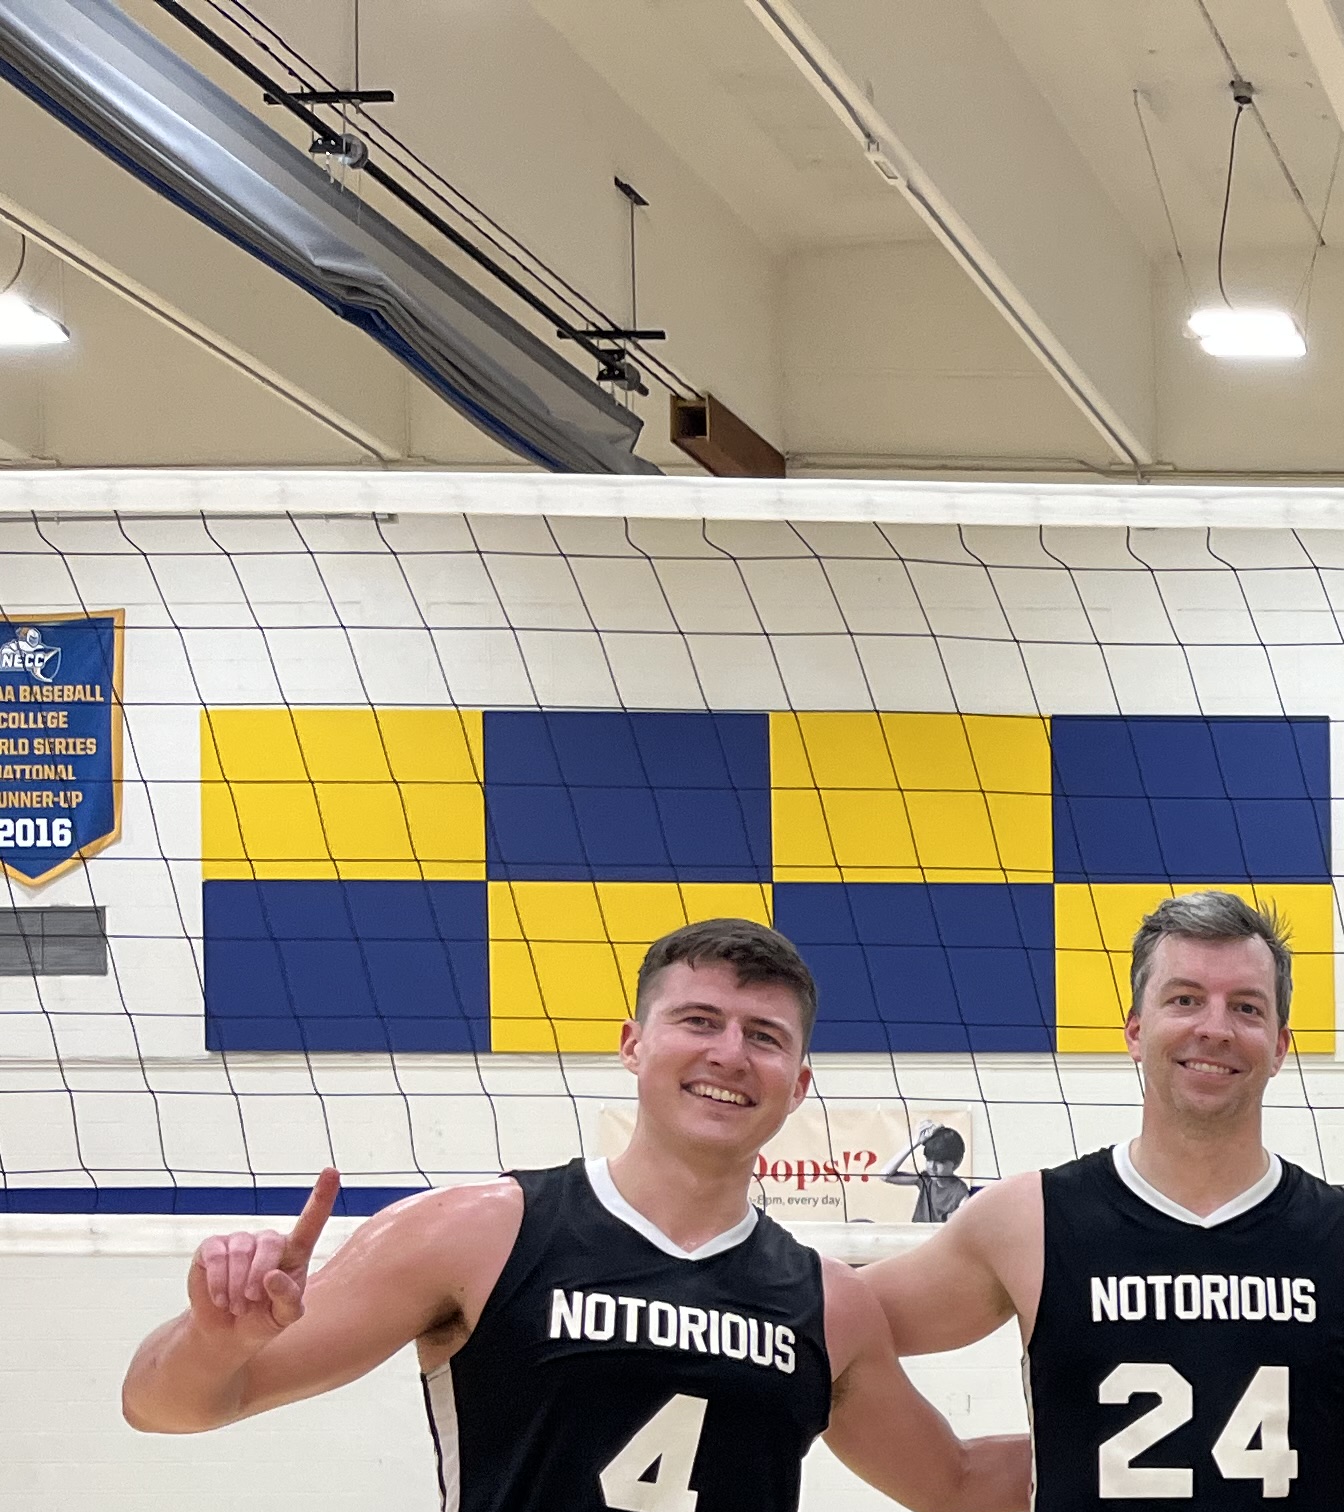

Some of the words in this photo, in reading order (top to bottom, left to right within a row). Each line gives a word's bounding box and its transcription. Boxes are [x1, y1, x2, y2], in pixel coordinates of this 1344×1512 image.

[2, 653, 45, 668] NECC
[19, 684, 105, 702] BASEBALL
[0, 711, 69, 729] COLLEGE
[0, 737, 30, 756] RLD
[33, 737, 97, 756] SERIES
[0, 764, 76, 781] ATIONAL
[0, 790, 83, 809] UNNER-UP
[0, 817, 73, 848] 2016
[787, 1196, 820, 1208] every
[1090, 1274, 1317, 1324] NOTORIOUS
[549, 1288, 796, 1375] NOTORIOUS
[1098, 1362, 1299, 1499] 24
